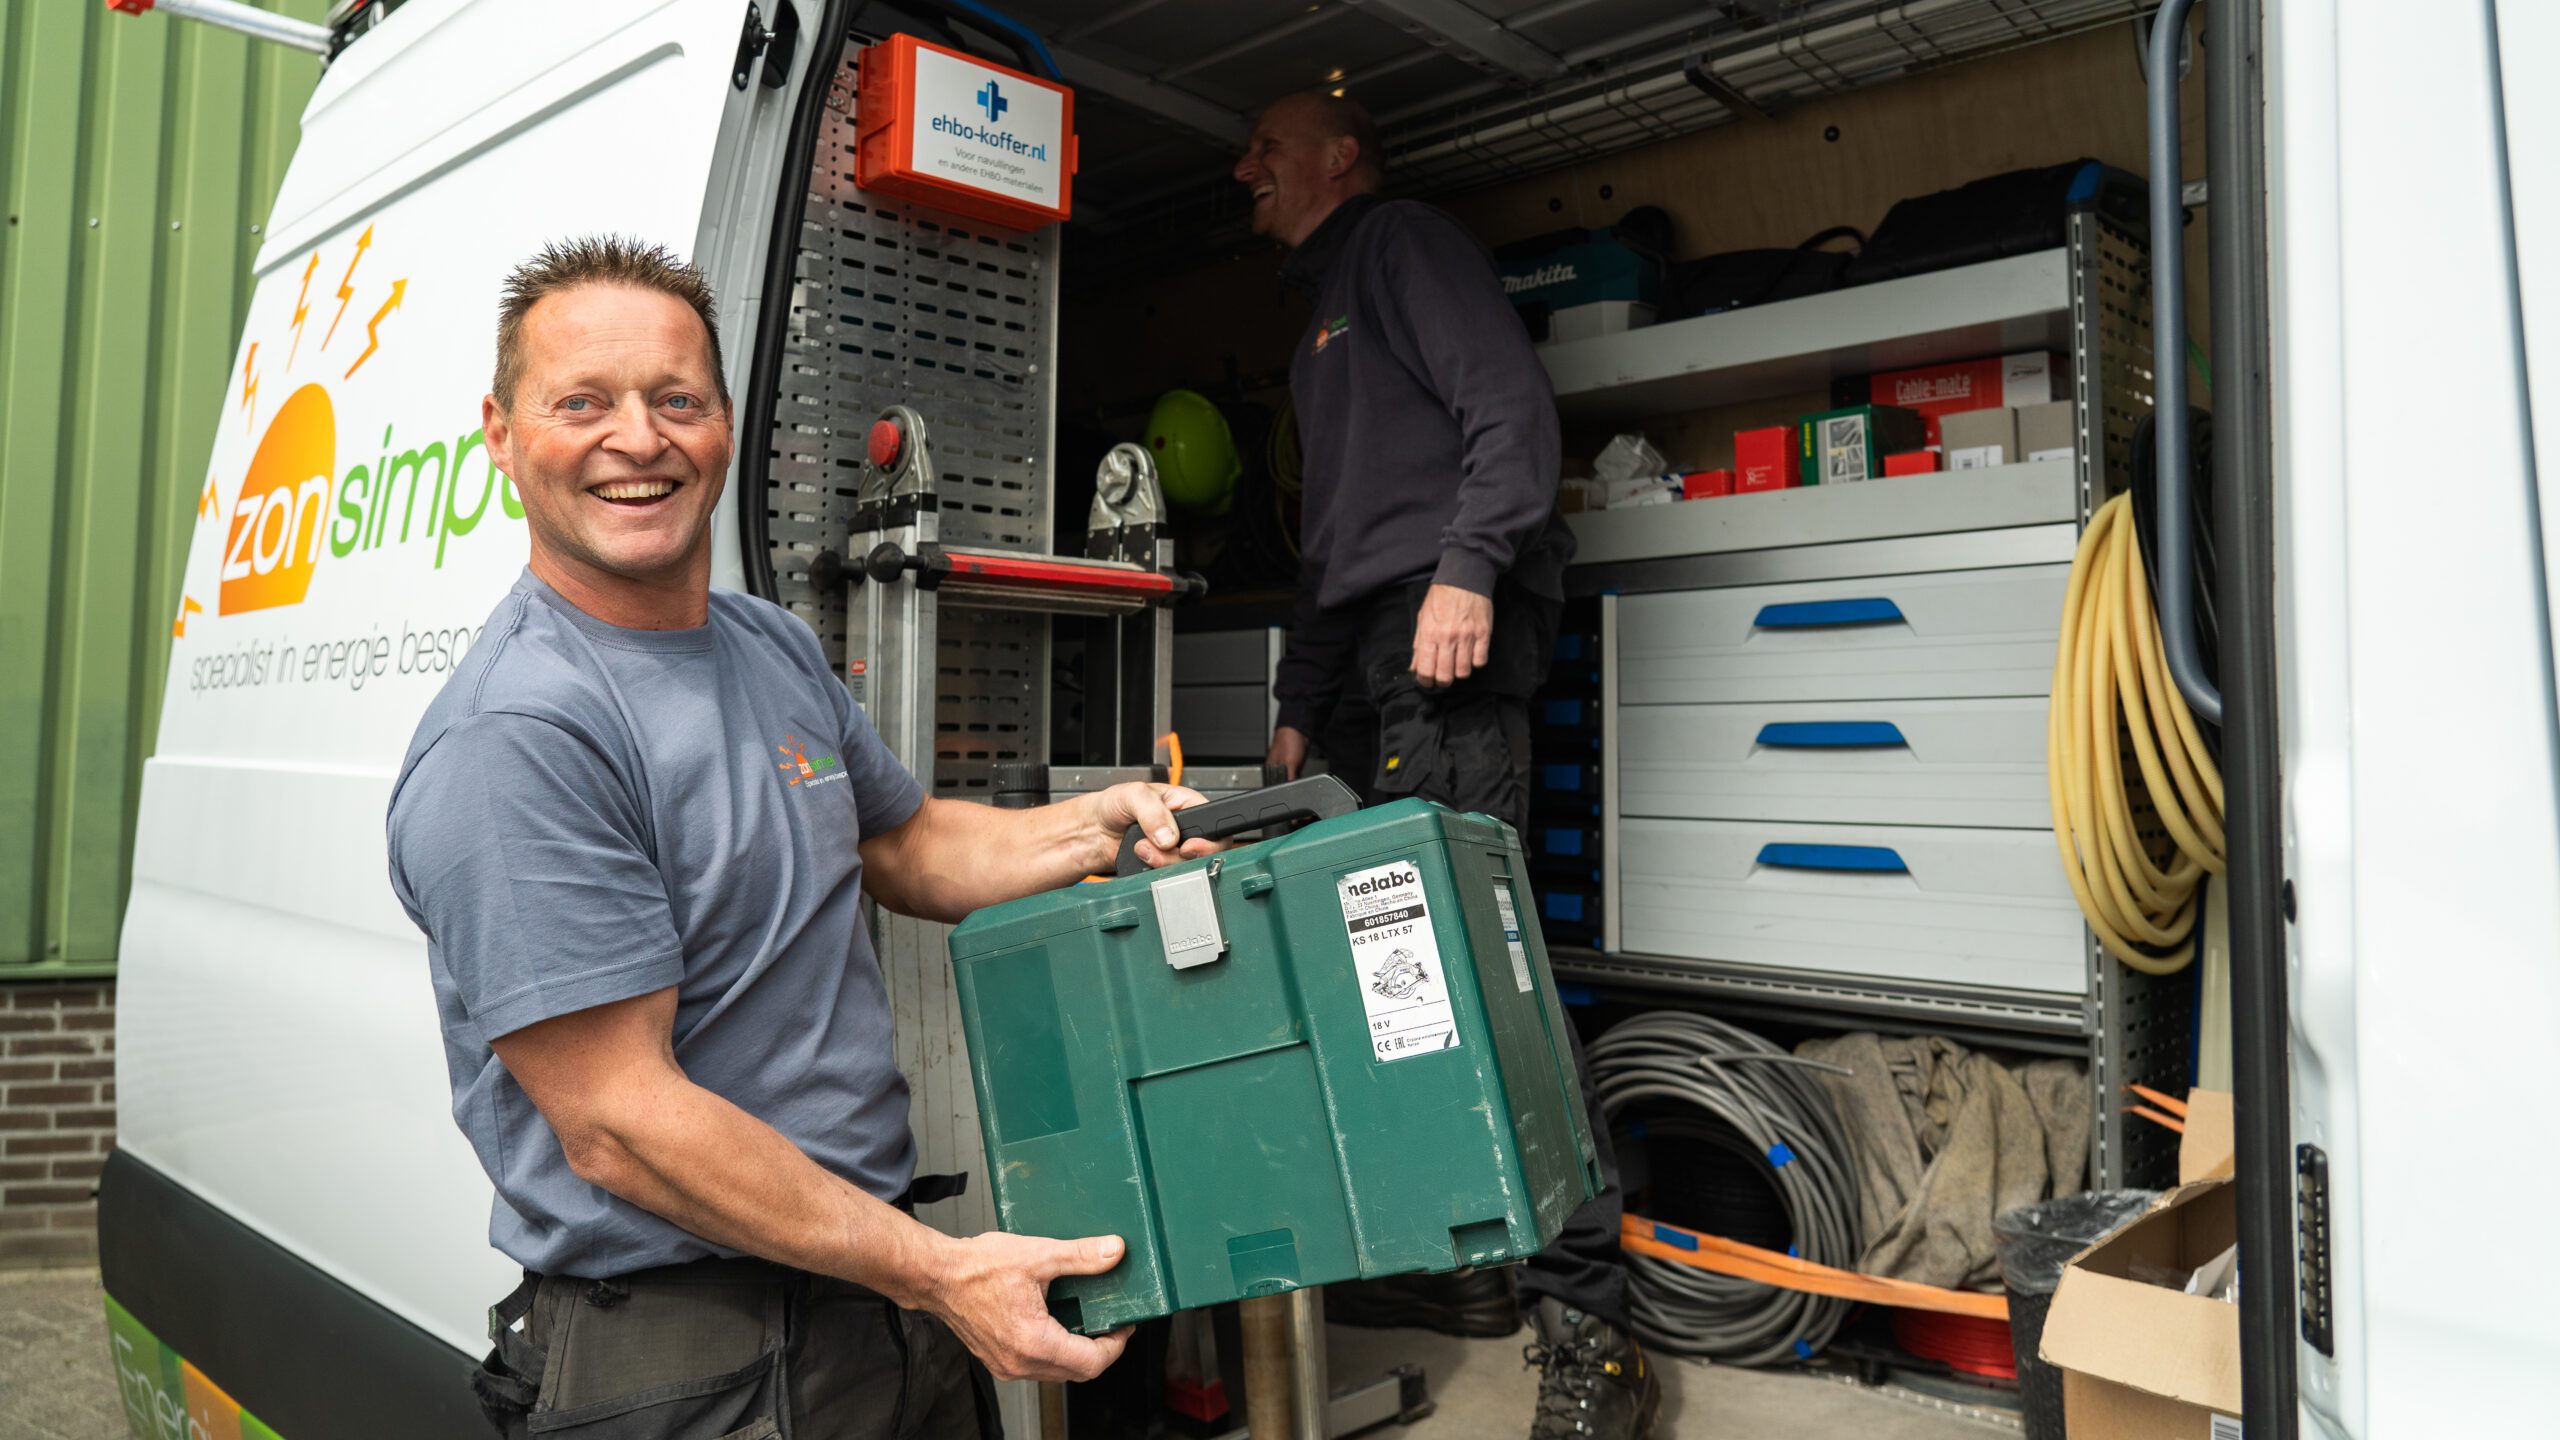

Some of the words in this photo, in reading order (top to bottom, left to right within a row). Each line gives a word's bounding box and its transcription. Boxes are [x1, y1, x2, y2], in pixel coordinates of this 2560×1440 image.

[932, 114, 1046, 162] ehbo-koffer.nl
[938, 159, 949, 168] en
[950, 162, 978, 176] andere
[954, 147, 976, 161] Voor
[977, 155, 1026, 176] navullingen
[1896, 373, 1972, 402] Cable-mate
[190, 638, 273, 698] specialist
[277, 634, 296, 683] in
[303, 623, 391, 692] energie
[397, 619, 484, 681] besp
[1364, 909, 1409, 927] 601857840
[1169, 934, 1213, 954] metabo
[1352, 936, 1366, 946] KS
[1368, 933, 1380, 943] 18
[1381, 928, 1401, 941] LTX
[1402, 924, 1413, 935] 57
[1372, 1022, 1383, 1031] 18
[1384, 1020, 1391, 1028] V
[114, 1331, 213, 1440] Ener
